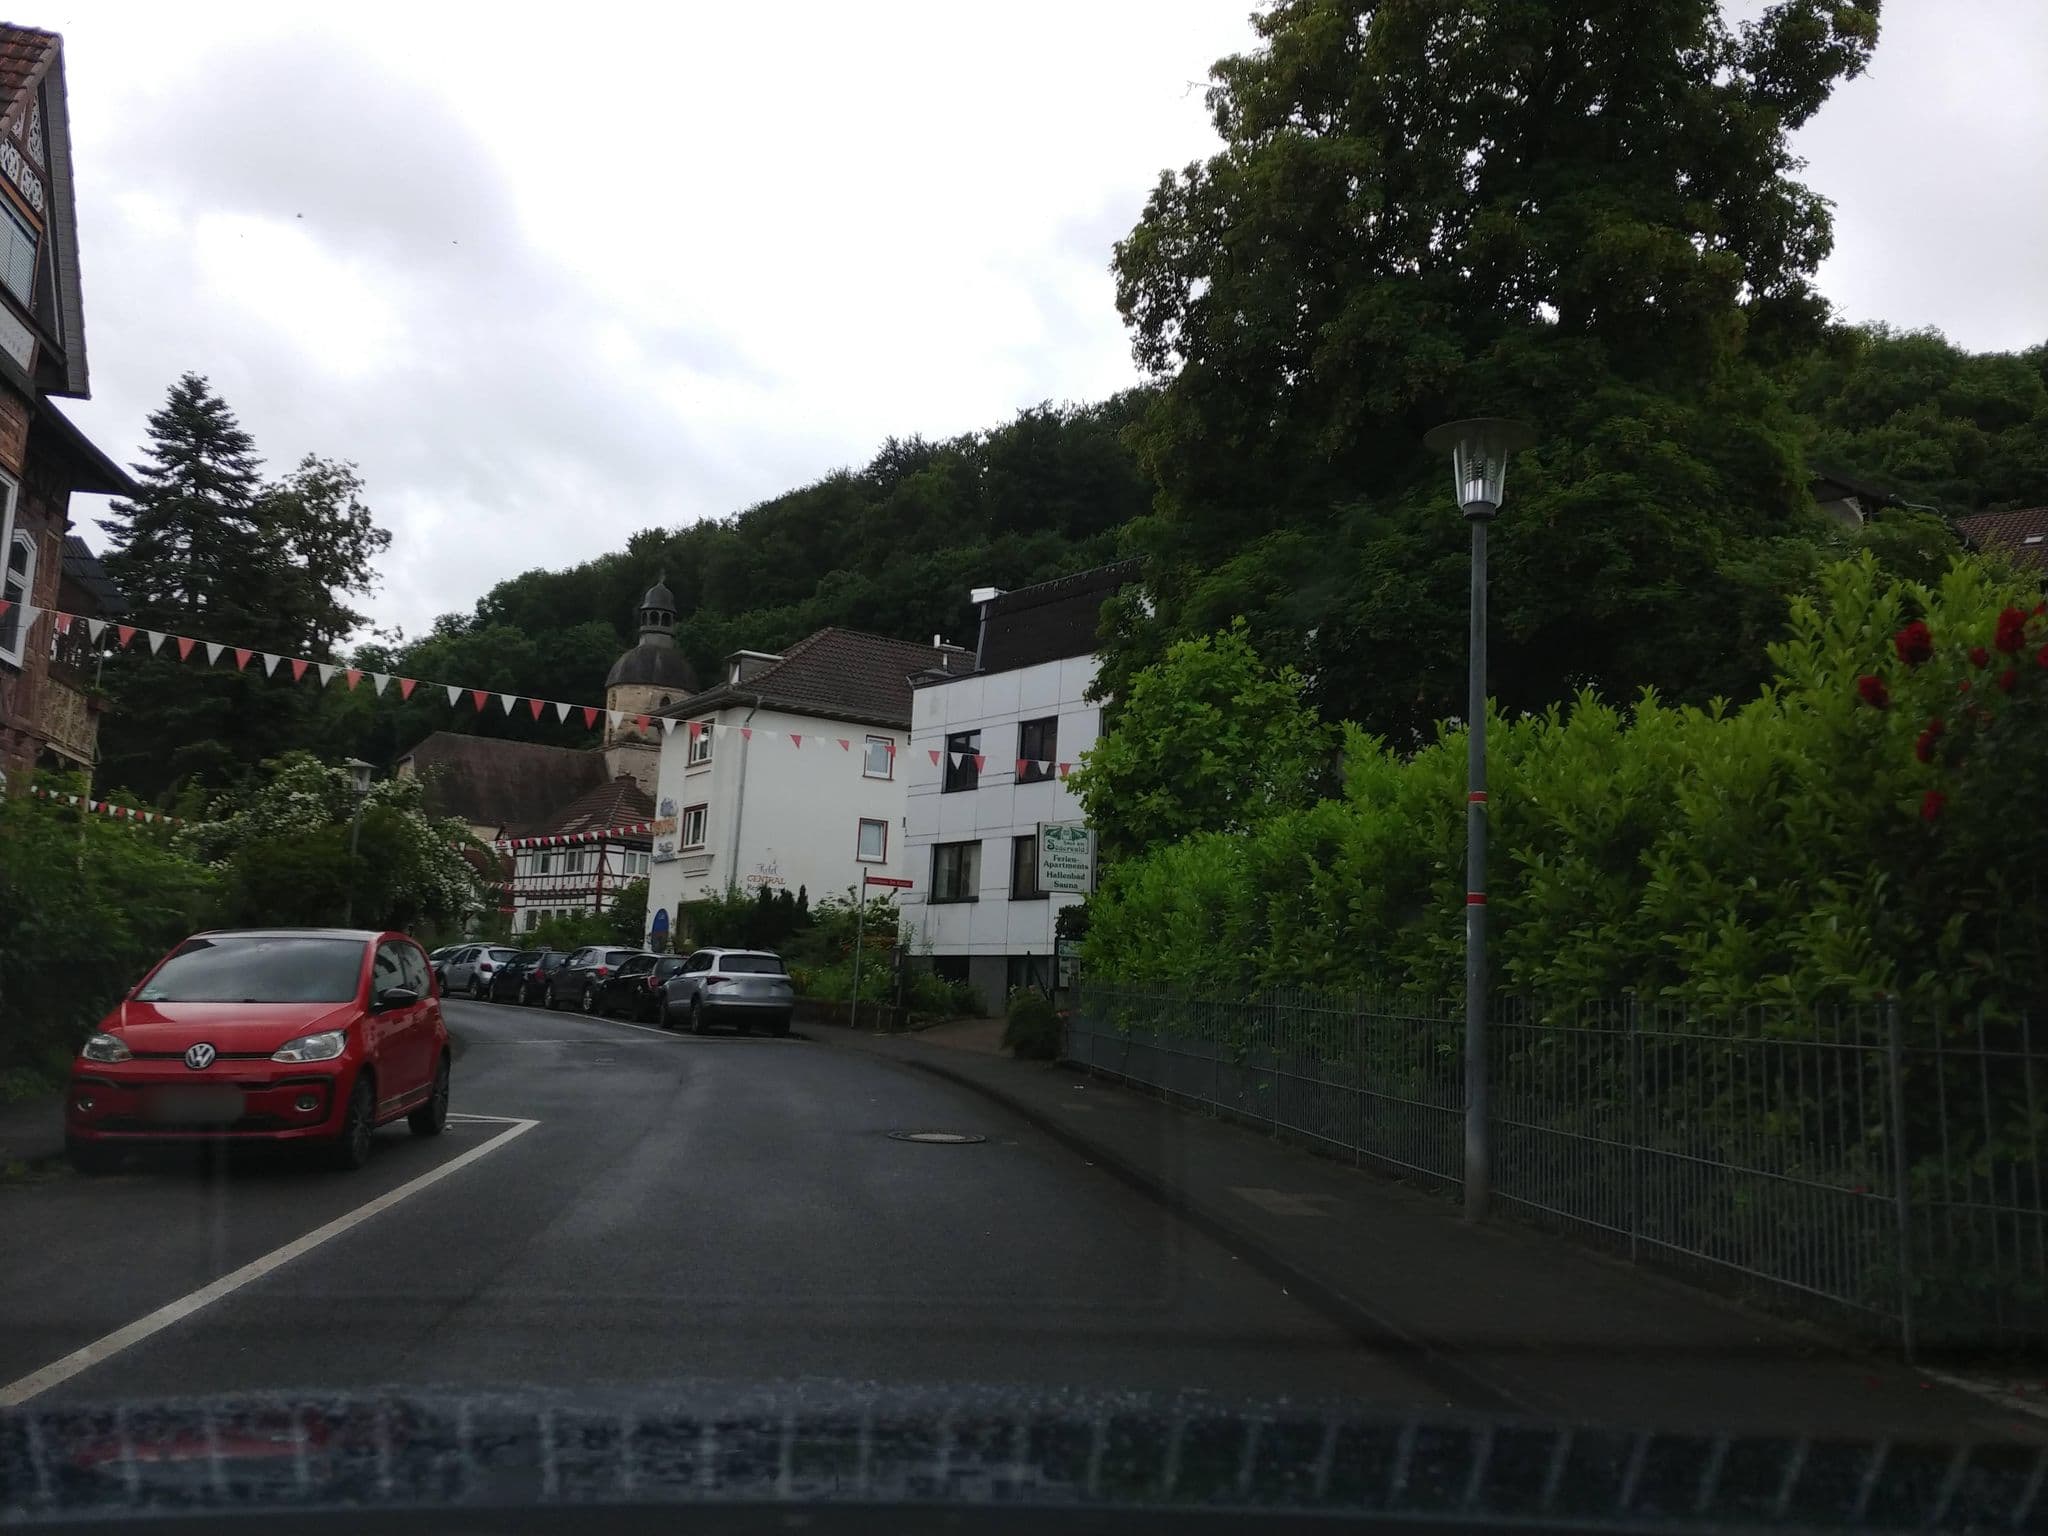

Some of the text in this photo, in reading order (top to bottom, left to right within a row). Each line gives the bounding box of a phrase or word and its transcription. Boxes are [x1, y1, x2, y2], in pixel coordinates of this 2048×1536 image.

[1053, 854, 1080, 863] Ferien-
[1044, 860, 1088, 869] Apartments
[1047, 870, 1085, 880] Hallenbad
